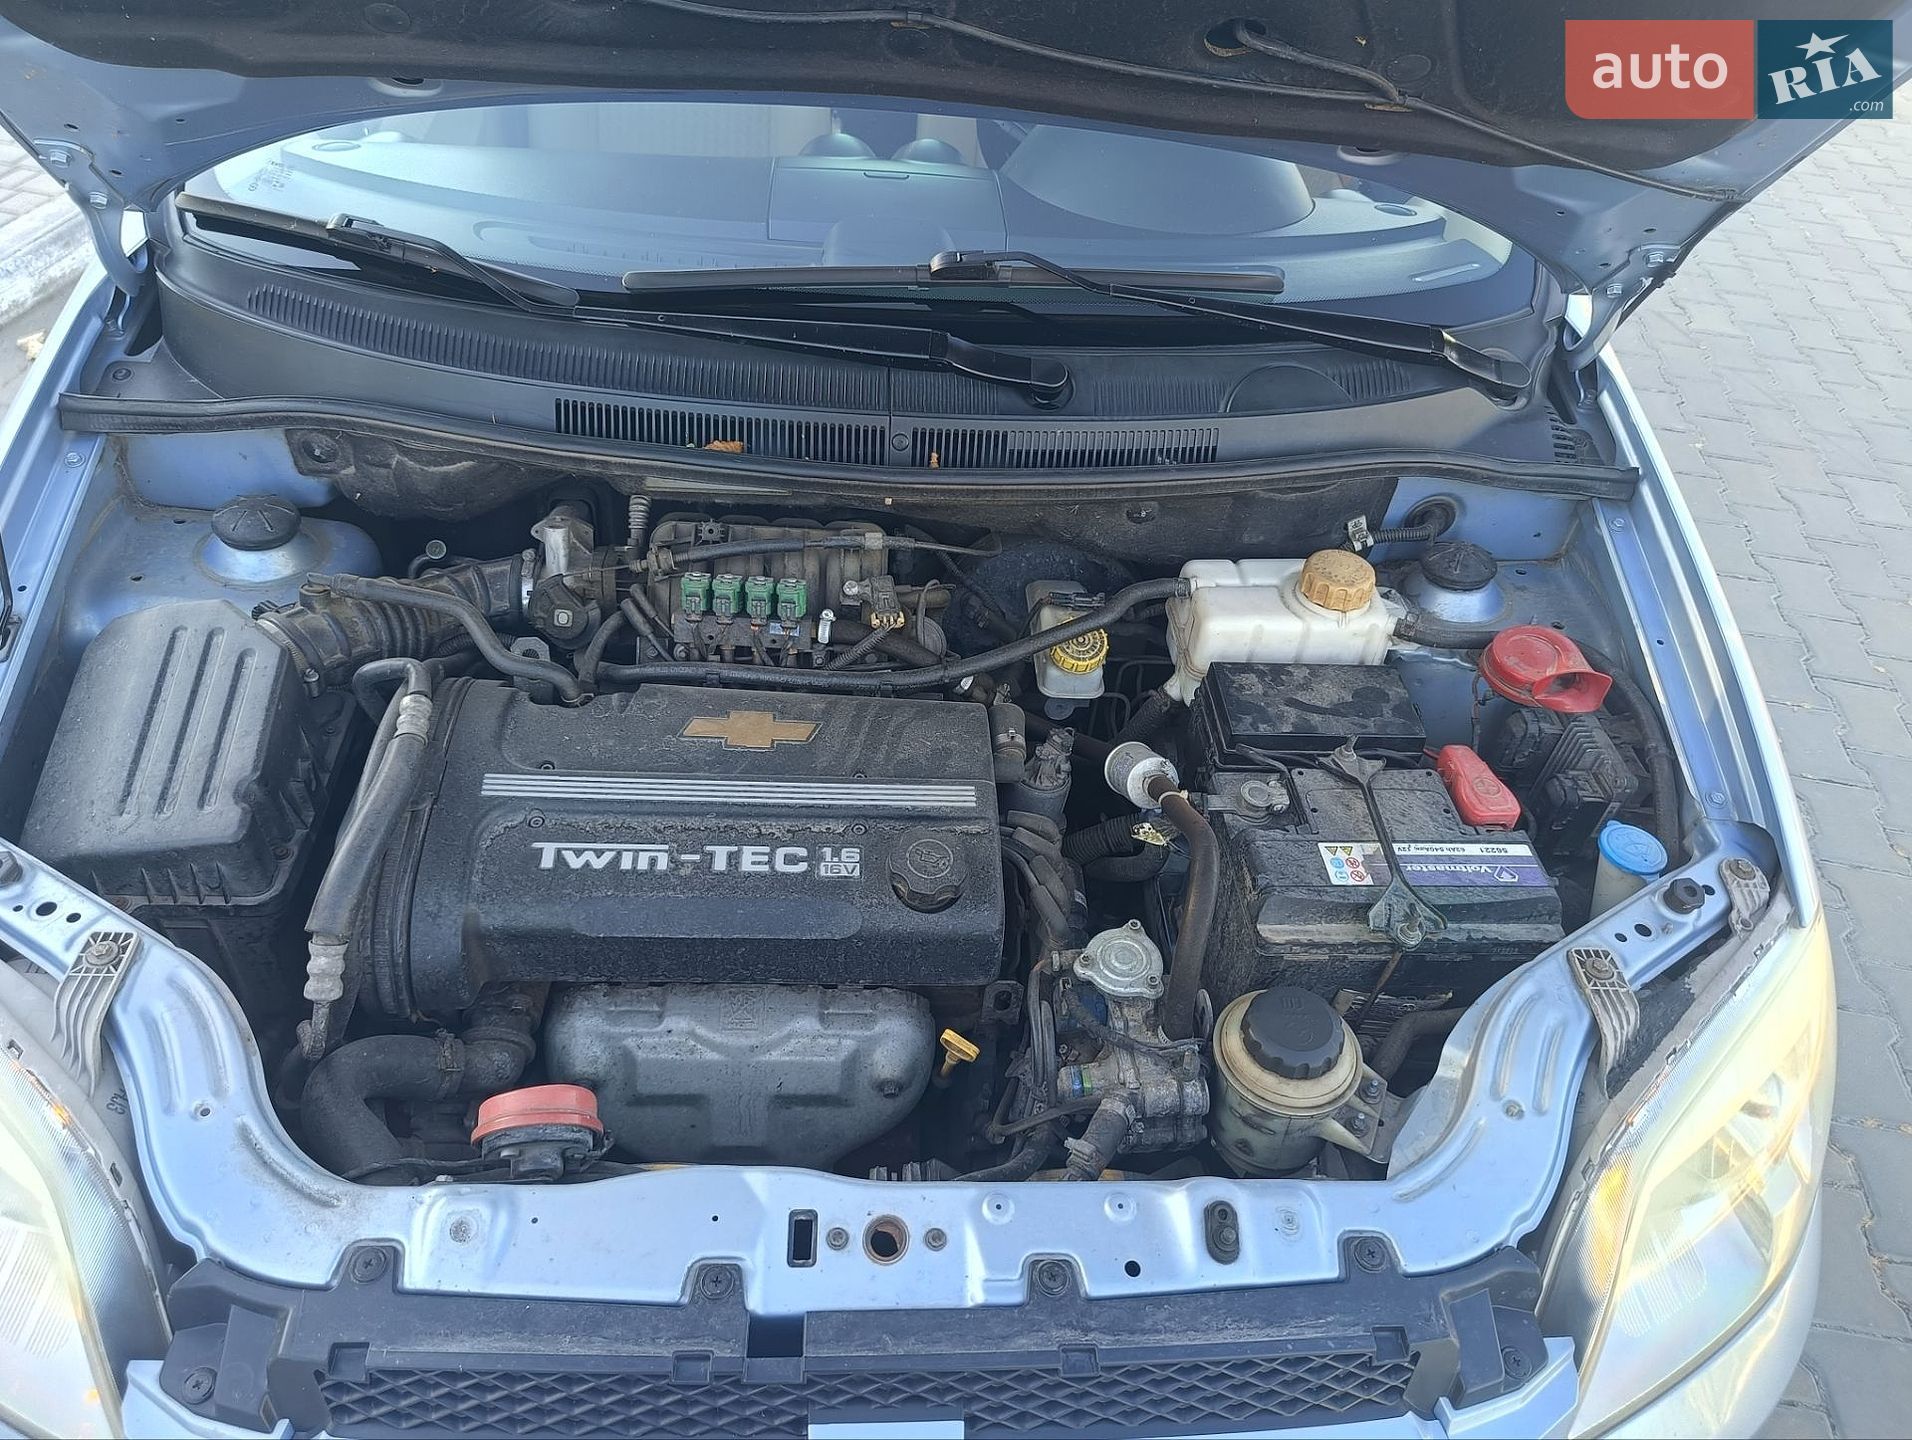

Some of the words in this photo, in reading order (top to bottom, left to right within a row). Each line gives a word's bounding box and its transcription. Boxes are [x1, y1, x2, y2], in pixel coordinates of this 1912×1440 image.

[531, 842, 808, 873] Twin-TEC
[820, 847, 860, 862] 1.6
[820, 862, 860, 877] 16V
[1406, 864, 1492, 873] Voltmaster
